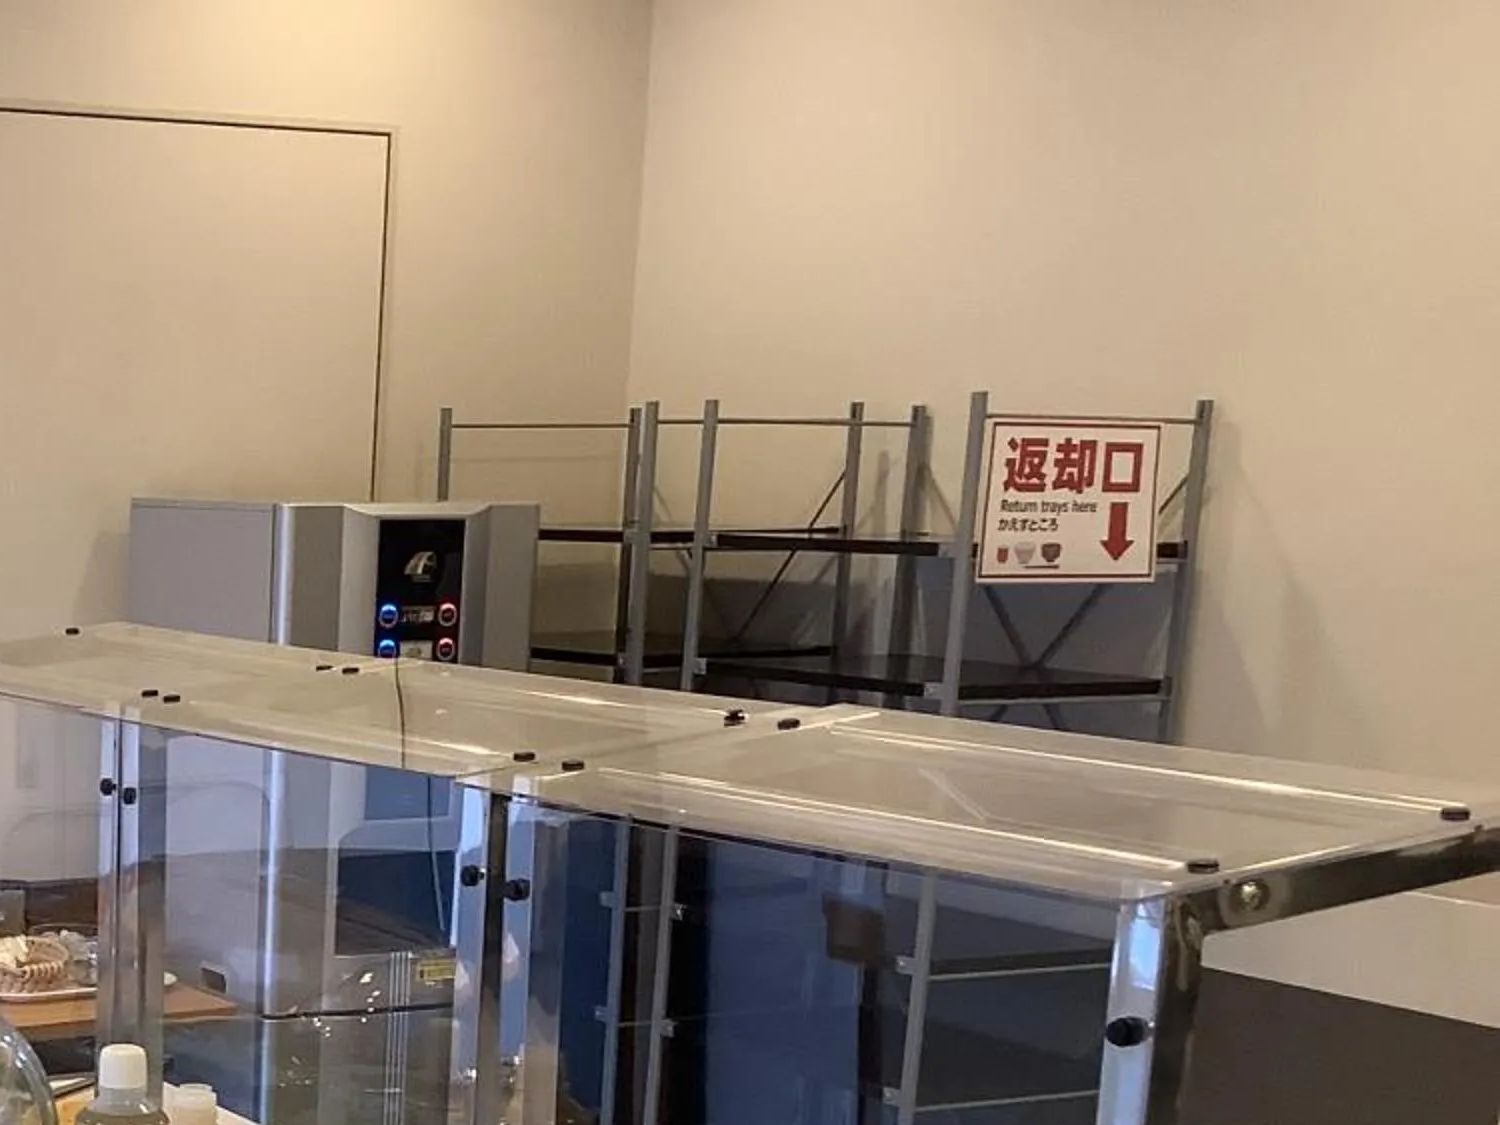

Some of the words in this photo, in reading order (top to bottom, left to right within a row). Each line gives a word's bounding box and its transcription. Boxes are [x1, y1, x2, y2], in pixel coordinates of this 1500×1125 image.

[1003, 437, 1144, 493] 返却口
[1001, 499, 1038, 513] Return
[1041, 500, 1069, 516] trays
[1072, 500, 1097, 513] here
[997, 517, 1059, 532] かえすところ
